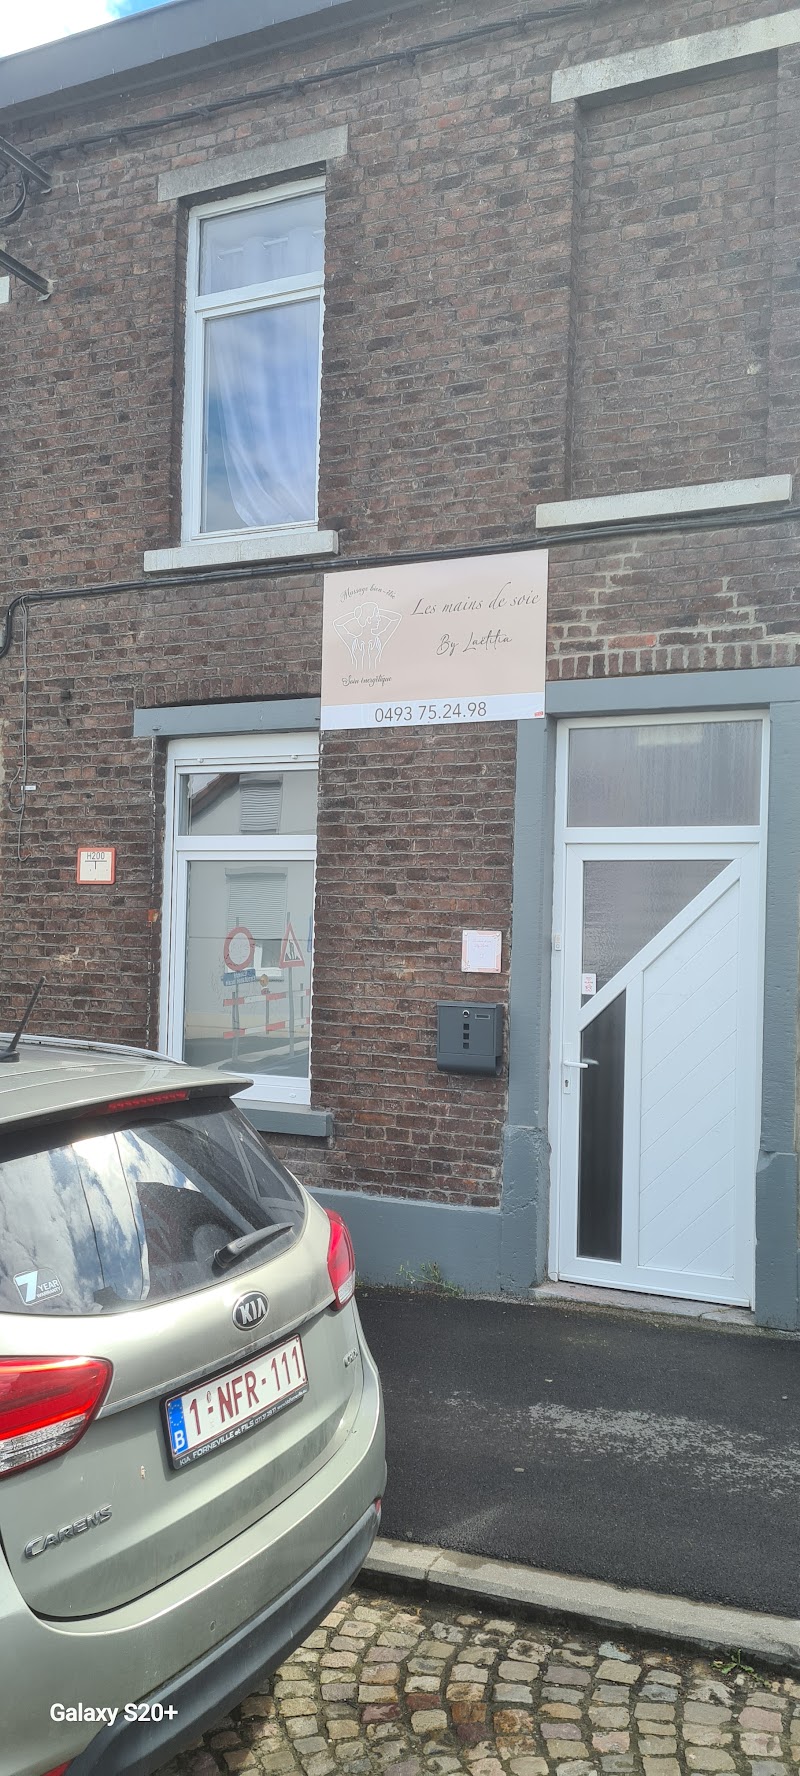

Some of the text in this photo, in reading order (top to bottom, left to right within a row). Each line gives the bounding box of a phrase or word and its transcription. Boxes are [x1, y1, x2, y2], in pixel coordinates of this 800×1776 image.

[410, 581, 541, 615] Les mains de soie
[436, 629, 512, 656] By Laëtitia
[374, 701, 487, 723] 0493 75.24.98
[86, 851, 105, 860] H200
[15, 1270, 60, 1302] 7 YEAR
[240, 1297, 267, 1325] KIA
[189, 1346, 302, 1436] 1-NFR-111
[174, 1429, 186, 1450] B
[179, 1456, 191, 1466] KIA
[192, 1431, 235, 1459] FORNEVILLE
[240, 1419, 255, 1432] FILS
[25, 1504, 112, 1559] CARENS
